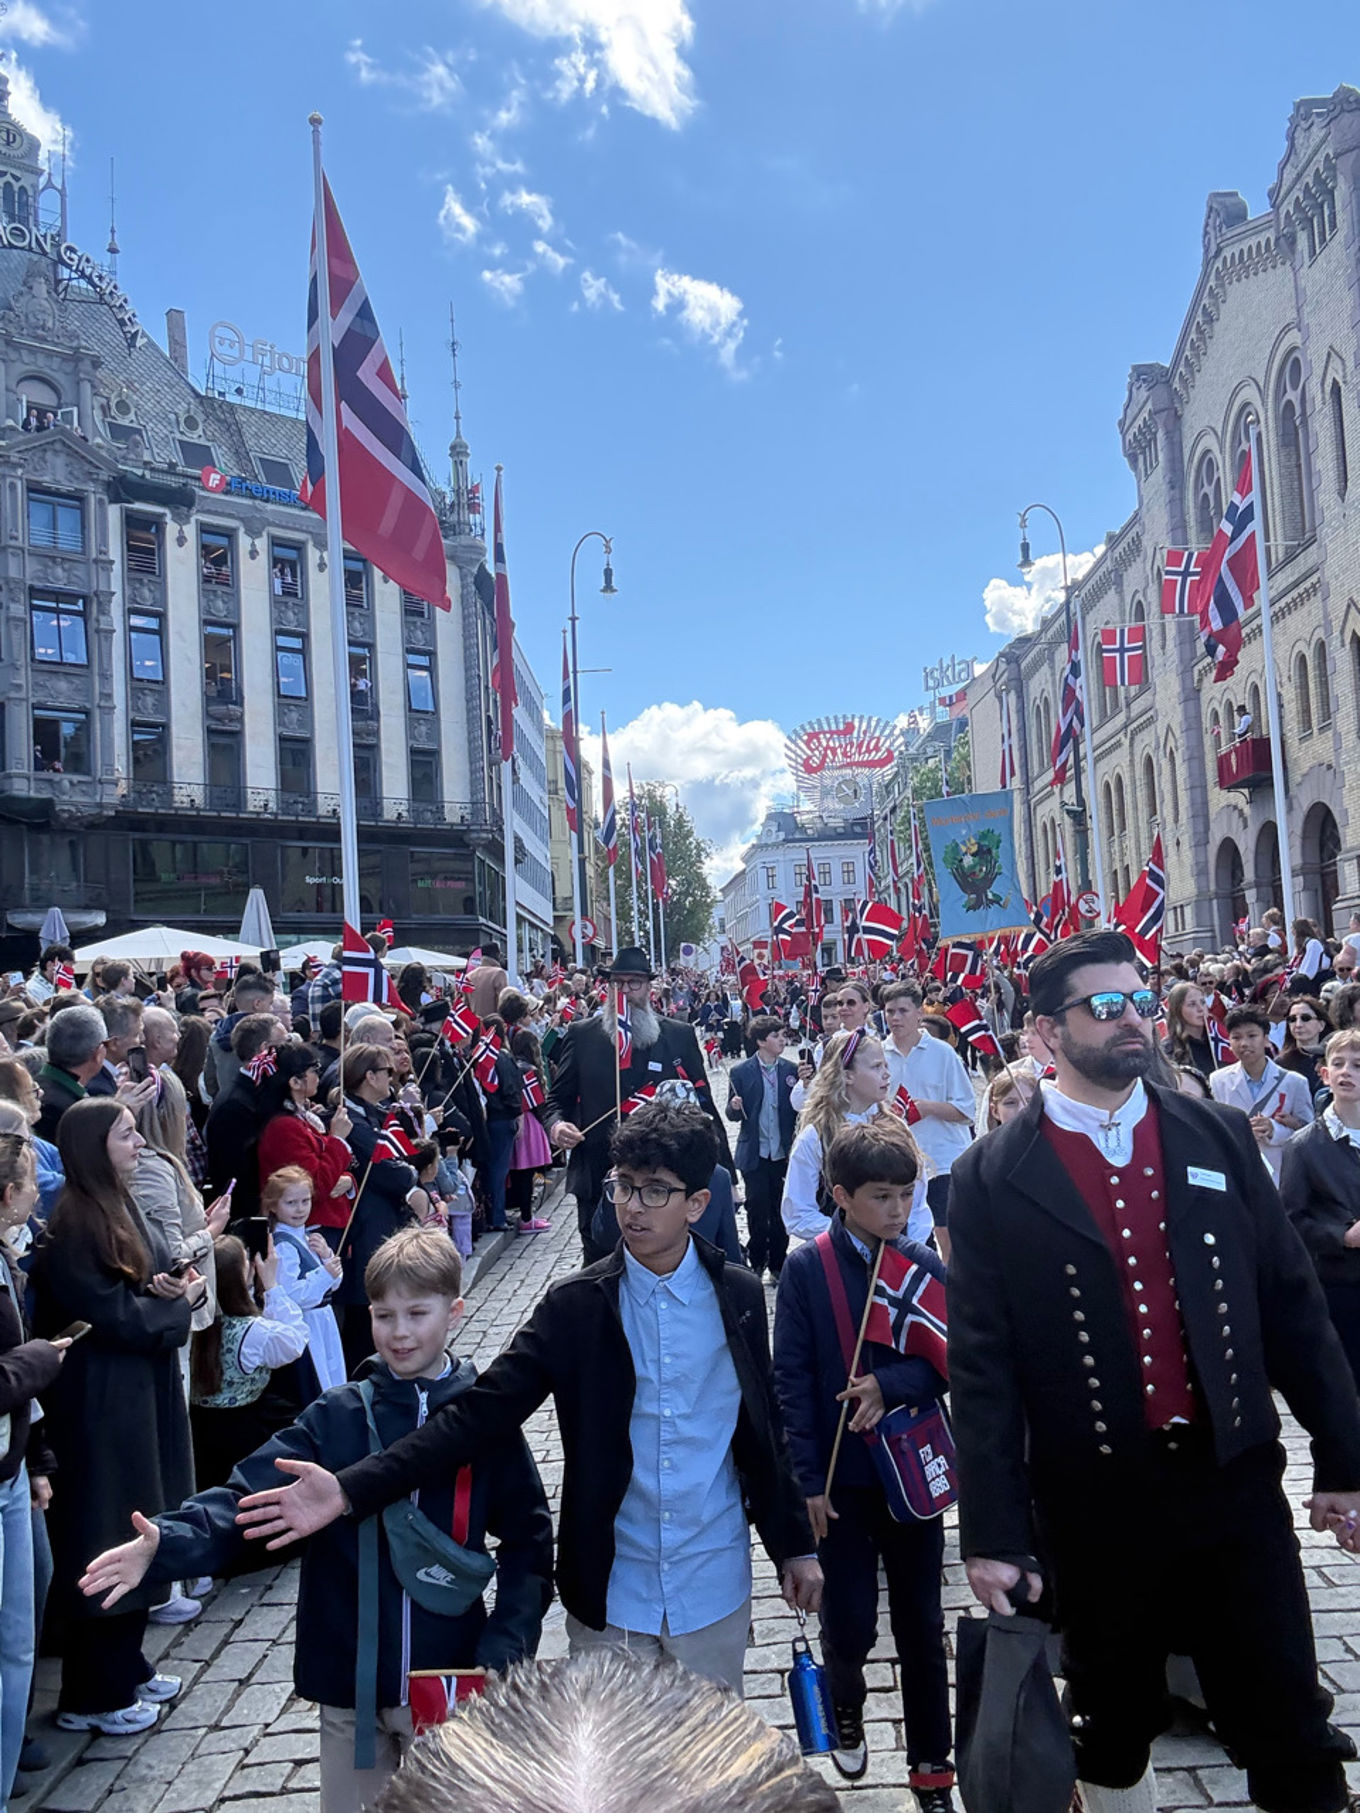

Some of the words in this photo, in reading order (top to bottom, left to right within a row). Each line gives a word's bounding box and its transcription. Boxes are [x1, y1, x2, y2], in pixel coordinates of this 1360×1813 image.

[803, 721, 894, 775] Freia
[305, 875, 326, 885] Sport
[427, 1563, 456, 1584] NIKE
